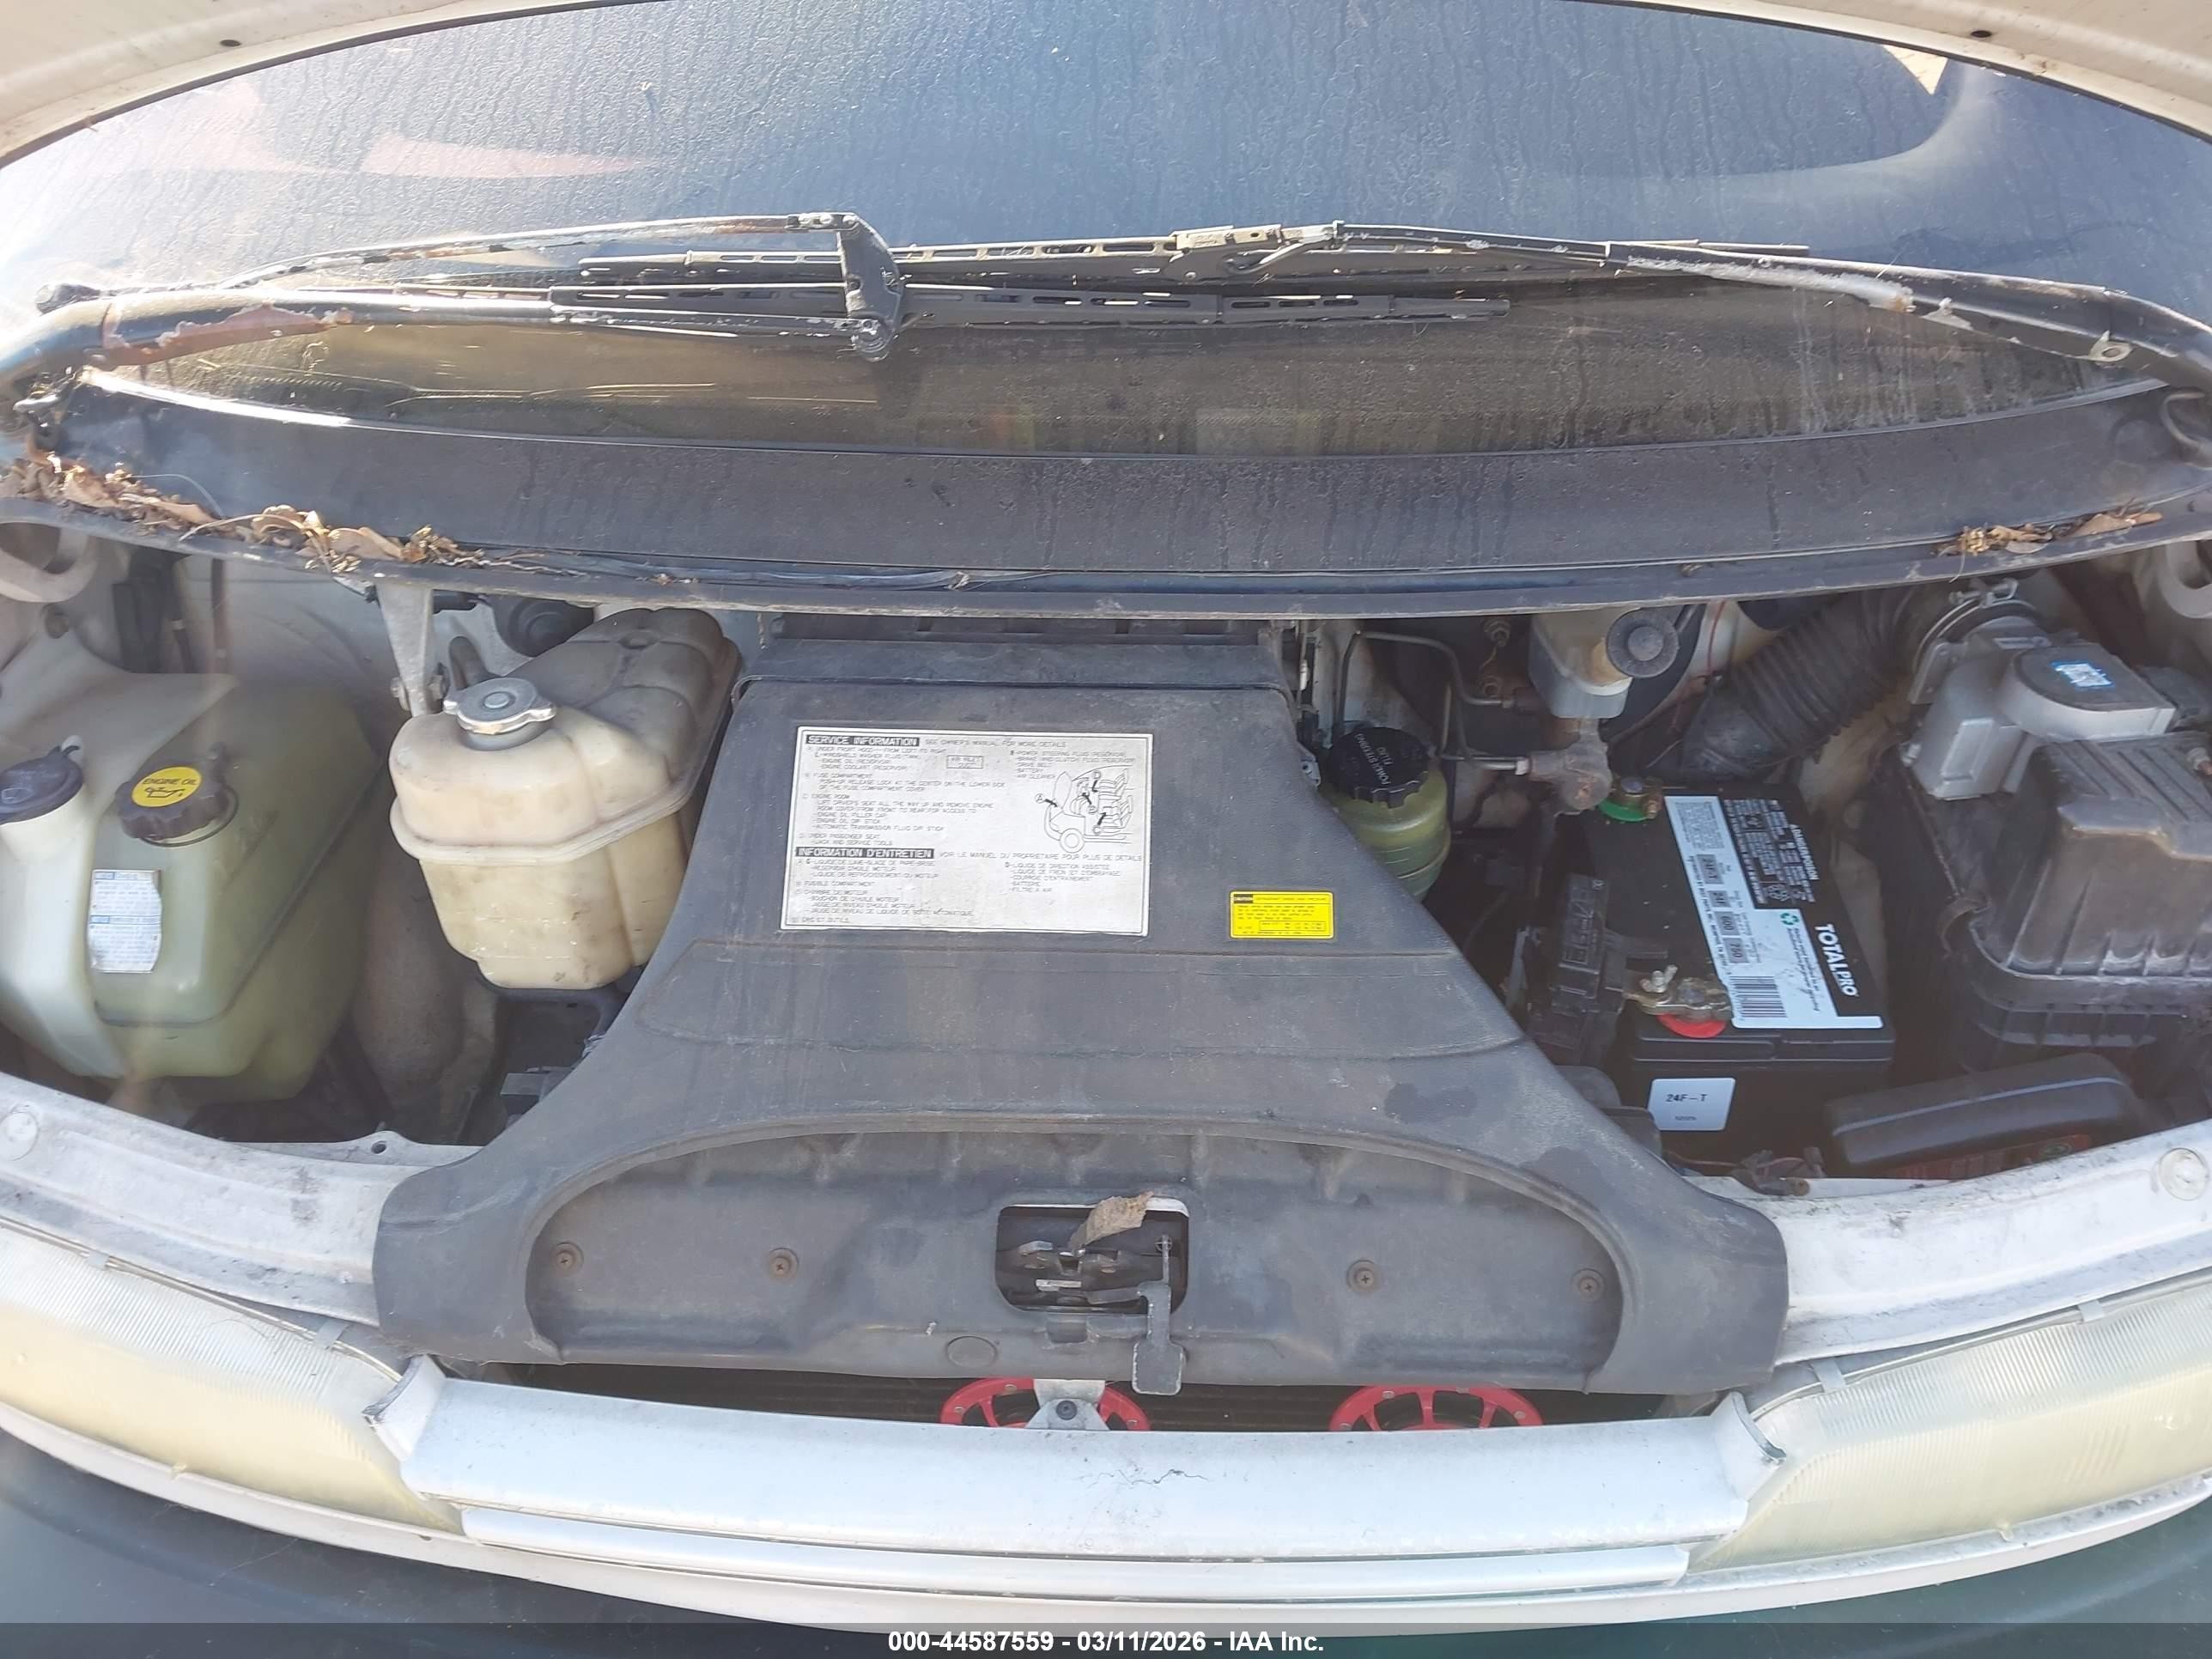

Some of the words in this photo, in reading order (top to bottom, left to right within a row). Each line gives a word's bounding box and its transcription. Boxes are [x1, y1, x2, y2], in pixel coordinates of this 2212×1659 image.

[808, 735, 850, 745] SERVICE
[854, 736, 918, 746] INFORMATION
[142, 777, 179, 786] ENGINE
[181, 776, 198, 786] OIL
[799, 848, 864, 859] INFORMATION
[866, 848, 933, 860] D'ENTRETIEN
[1720, 915, 1735, 932] 600
[1814, 924, 1858, 996] TOTALPRO
